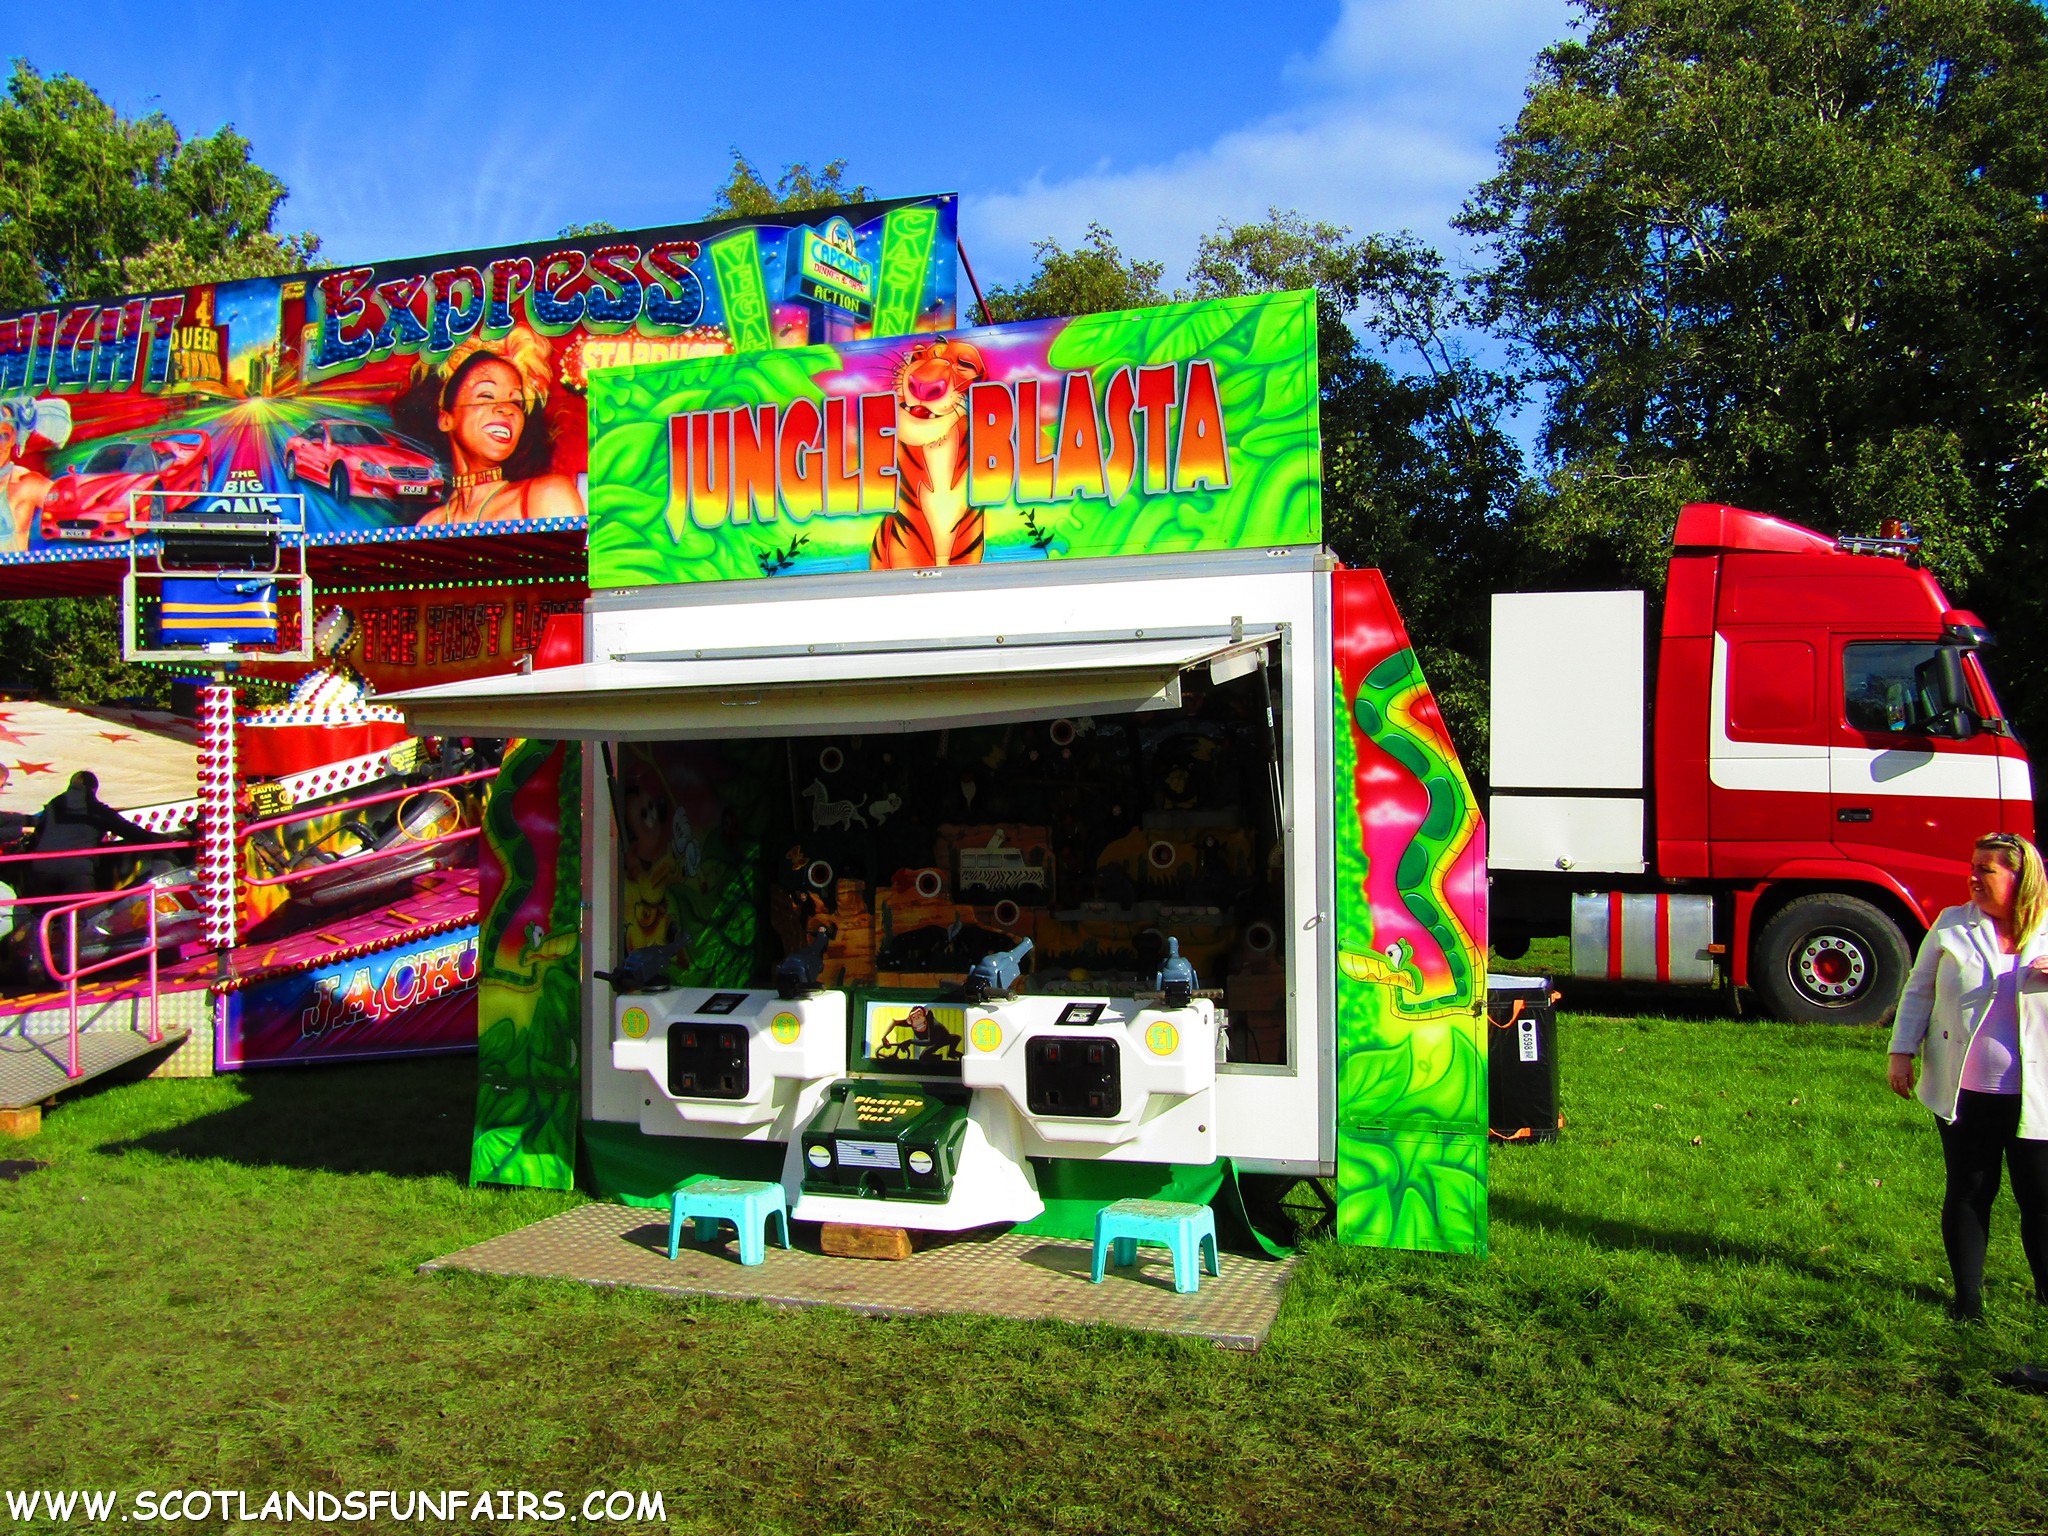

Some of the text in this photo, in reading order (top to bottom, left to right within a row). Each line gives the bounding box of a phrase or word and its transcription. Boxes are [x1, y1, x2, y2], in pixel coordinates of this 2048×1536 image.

[814, 262, 840, 282] DINNER
[883, 213, 928, 335] CASIN
[314, 240, 704, 372] Express
[716, 242, 768, 353] VEGA
[814, 285, 860, 313] ACTION
[665, 357, 1231, 544] JUNGLE BLASTA
[230, 469, 257, 479] THE
[222, 479, 264, 493] BIG
[362, 607, 418, 665] THE
[427, 603, 505, 665] FAST
[513, 600, 584, 651] LA
[302, 936, 479, 1037] JACK
[626, 1011, 645, 1033] £1
[777, 1016, 796, 1039] £1
[976, 1024, 996, 1046] £1
[1151, 1026, 1172, 1050] £1
[1522, 1033, 1534, 1050] 6598
[853, 1096, 924, 1107] Please Do
[857, 1105, 885, 1114] Not
[857, 1113, 893, 1123] Here
